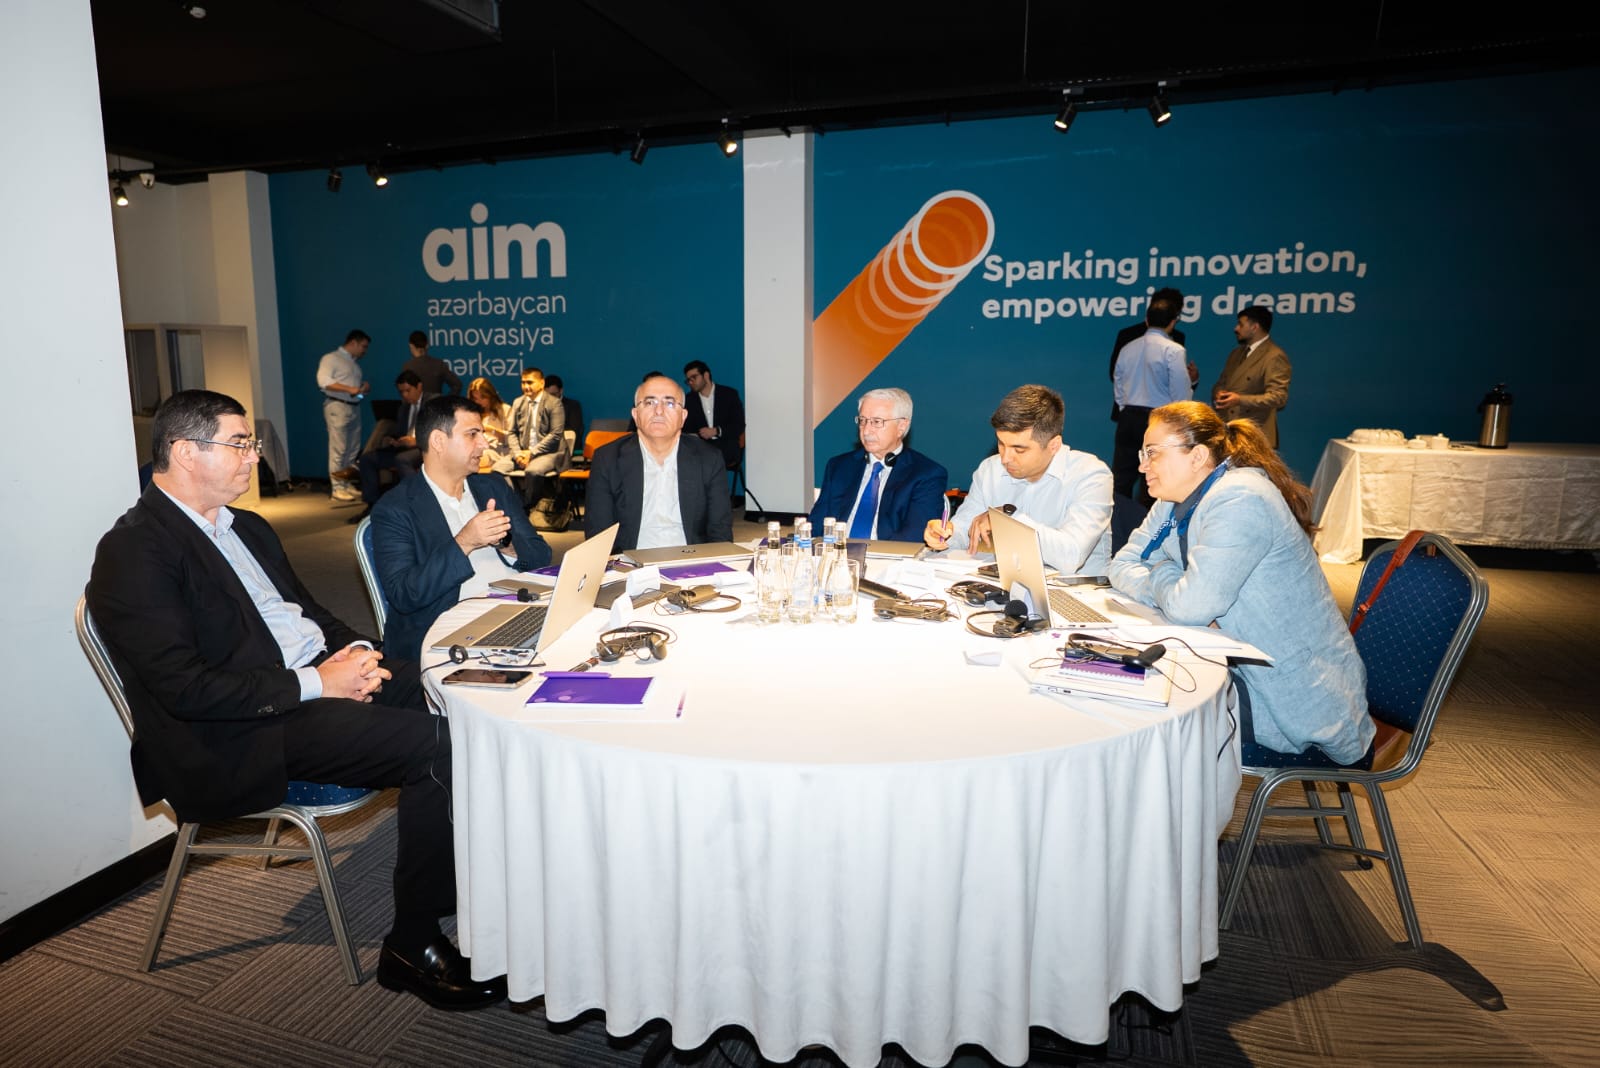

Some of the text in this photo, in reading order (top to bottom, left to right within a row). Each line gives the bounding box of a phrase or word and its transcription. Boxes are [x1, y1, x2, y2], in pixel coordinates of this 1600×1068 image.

[422, 203, 567, 283] aim
[982, 242, 1368, 287] Sparking innovation,
[427, 290, 566, 321] azərbaycan
[982, 286, 1356, 324] empowerig dreams
[428, 321, 554, 351] innovasiya
